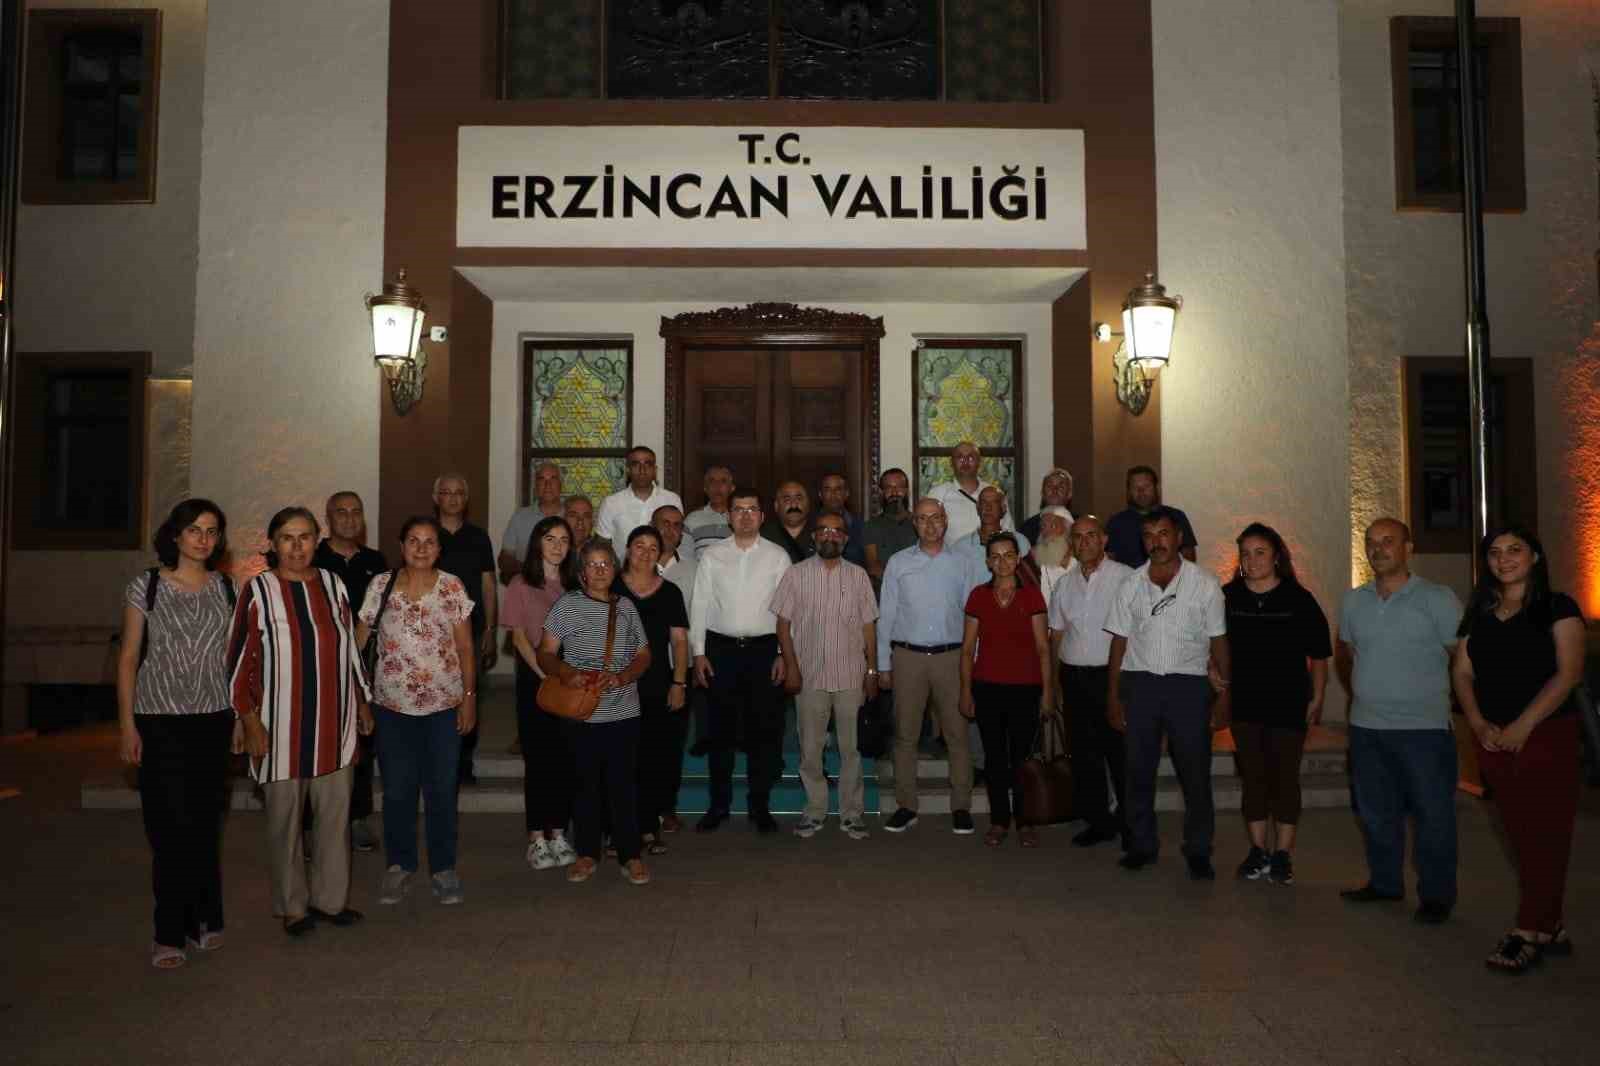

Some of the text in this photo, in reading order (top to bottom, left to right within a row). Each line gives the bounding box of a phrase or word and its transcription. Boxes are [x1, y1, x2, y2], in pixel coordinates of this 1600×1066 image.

[738, 132, 811, 165] T.C.
[492, 164, 1046, 220] ERZİNCAN VALİLİĞİ
